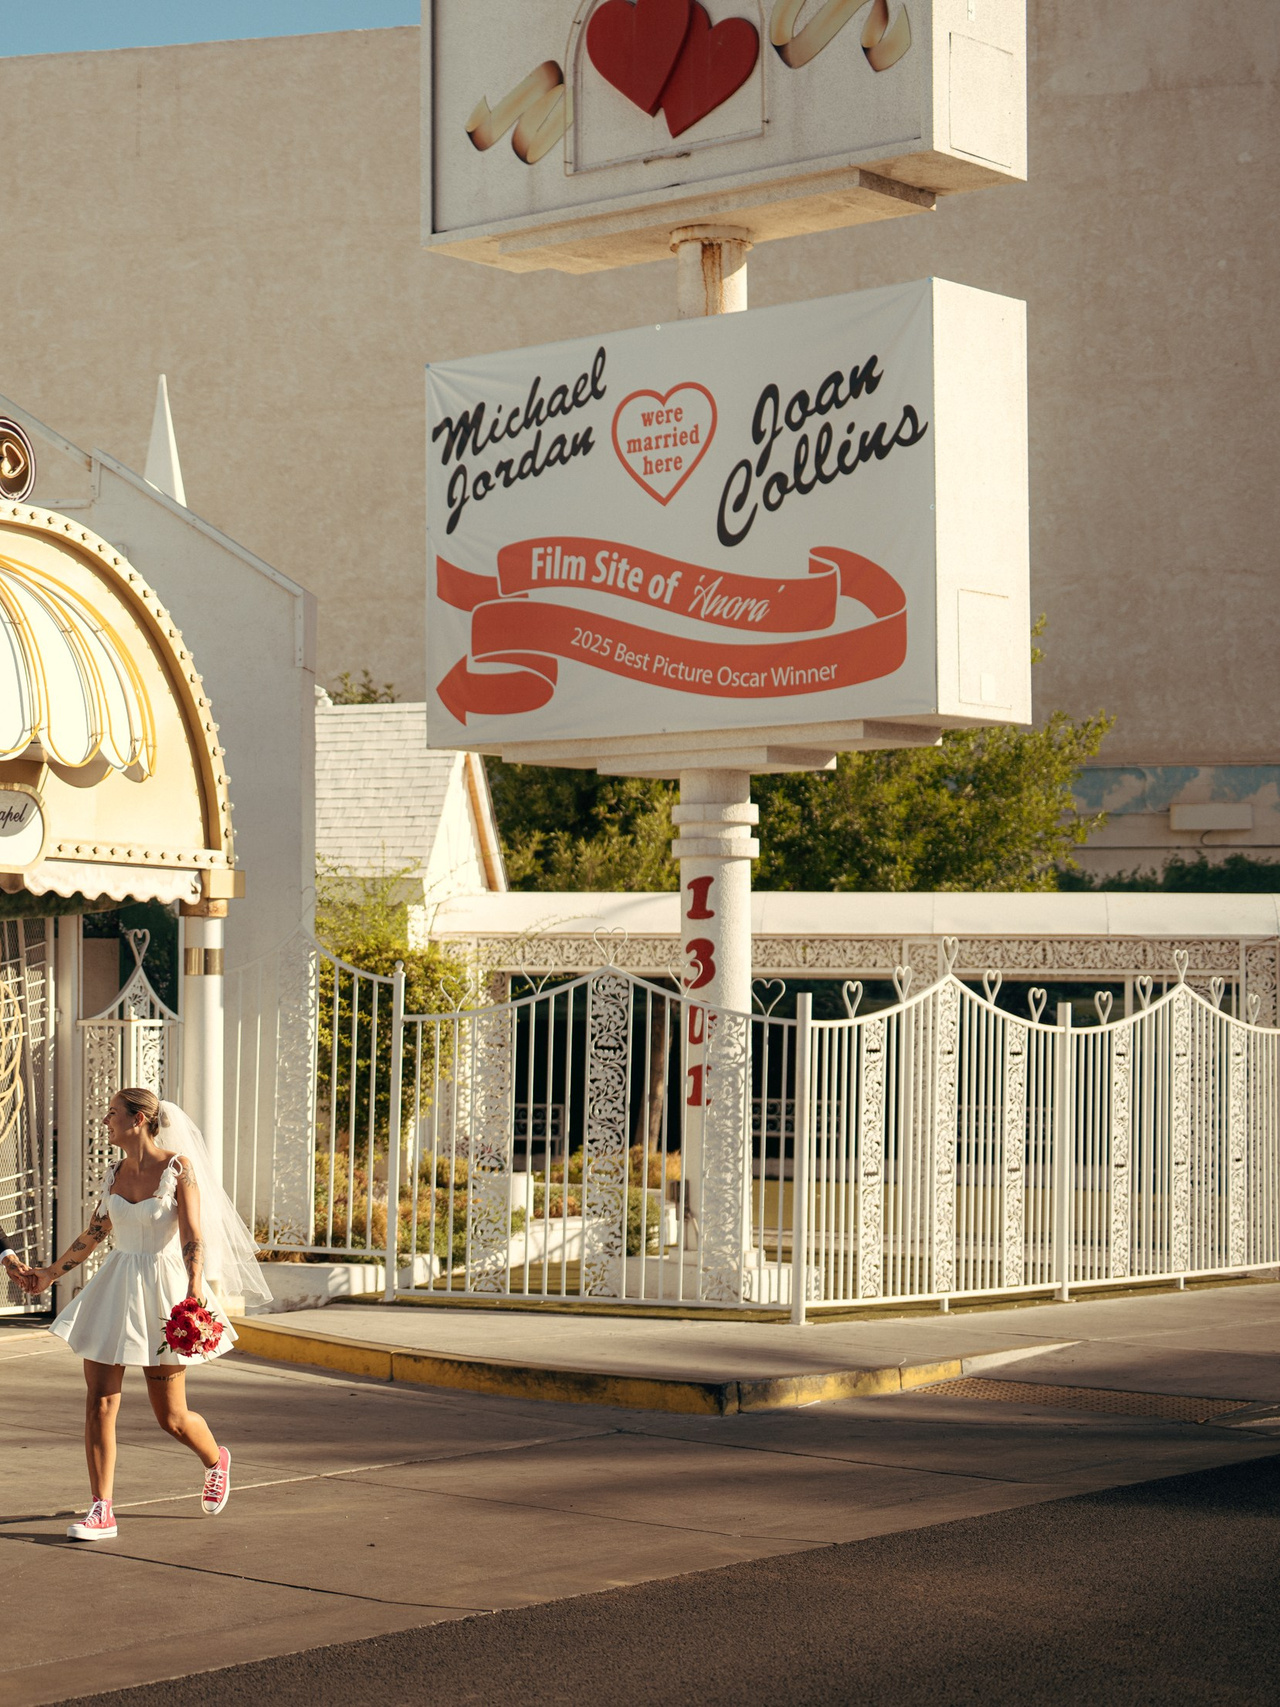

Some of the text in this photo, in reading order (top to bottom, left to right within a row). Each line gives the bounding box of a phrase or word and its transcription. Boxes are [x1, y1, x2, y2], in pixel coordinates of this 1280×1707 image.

[432, 346, 607, 465] Michael
[641, 407, 683, 428] were
[752, 355, 884, 477] Joan
[627, 424, 700, 453] married
[643, 453, 683, 475] here
[445, 425, 596, 535] Jordan
[717, 404, 928, 547] Collins
[531, 546, 586, 580] Film
[592, 550, 643, 592] Site
[648, 570, 683, 604] of
[570, 627, 837, 687] 2025 Best Picture Oscar Winner
